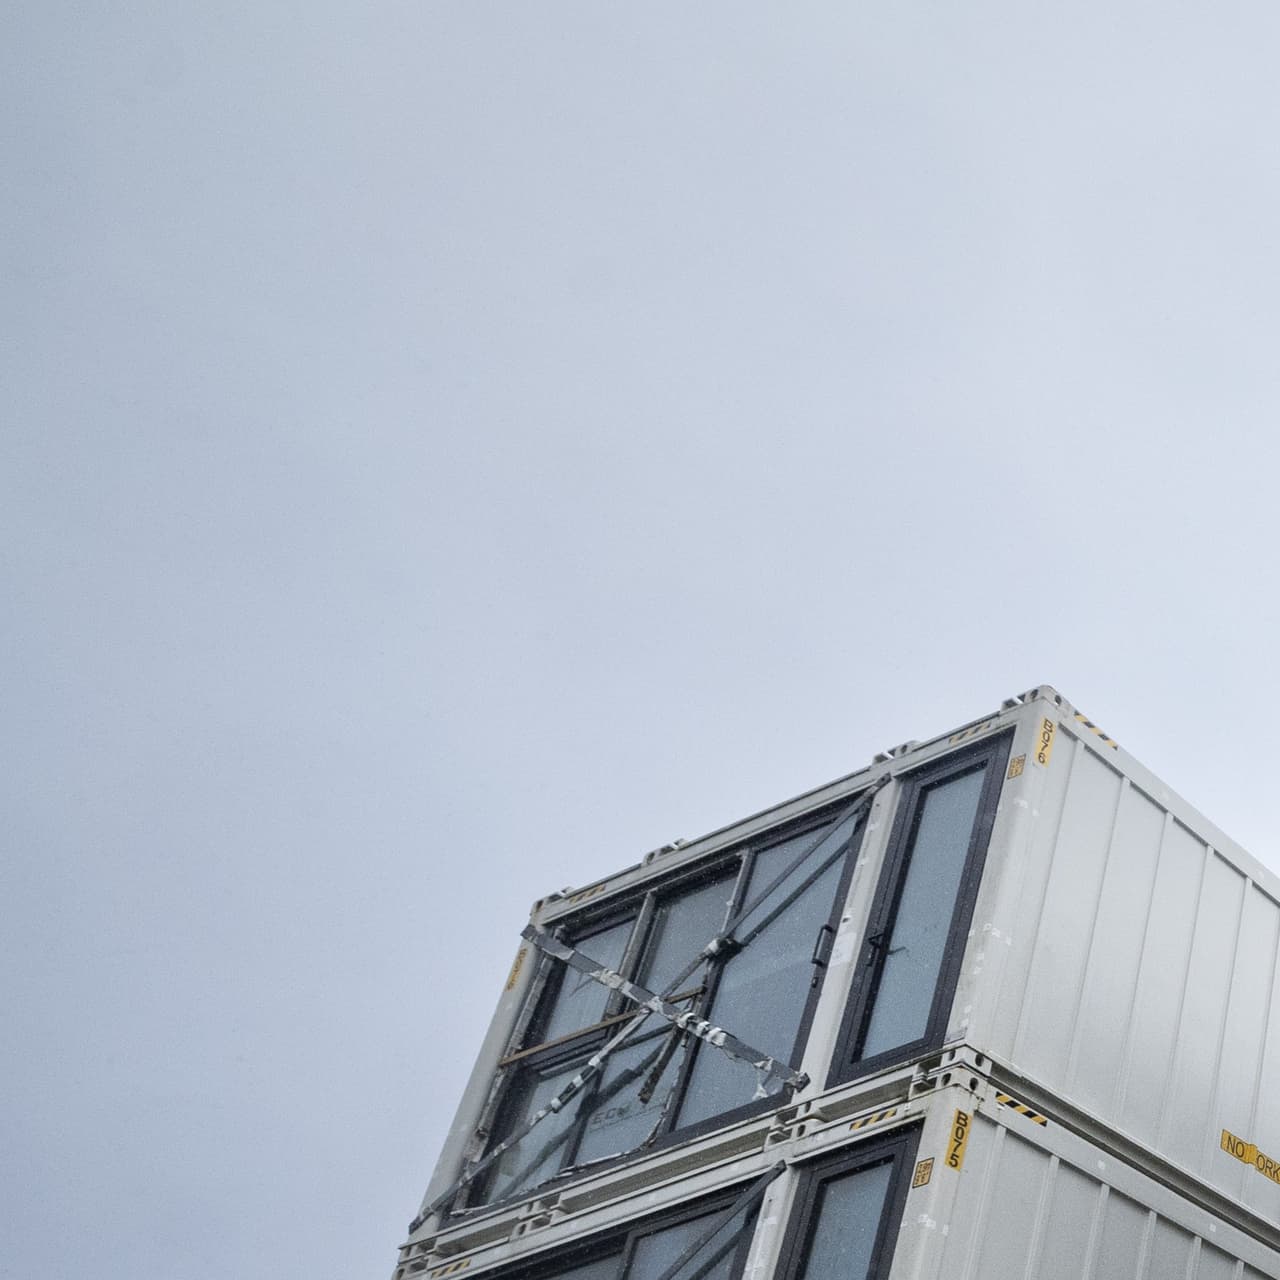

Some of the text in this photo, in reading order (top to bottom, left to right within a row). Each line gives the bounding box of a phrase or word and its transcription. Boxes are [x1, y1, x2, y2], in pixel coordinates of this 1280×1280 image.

[1038, 718, 1054, 764] B076
[949, 1110, 969, 1168] B075
[1226, 1136, 1280, 1182] NO ORK
